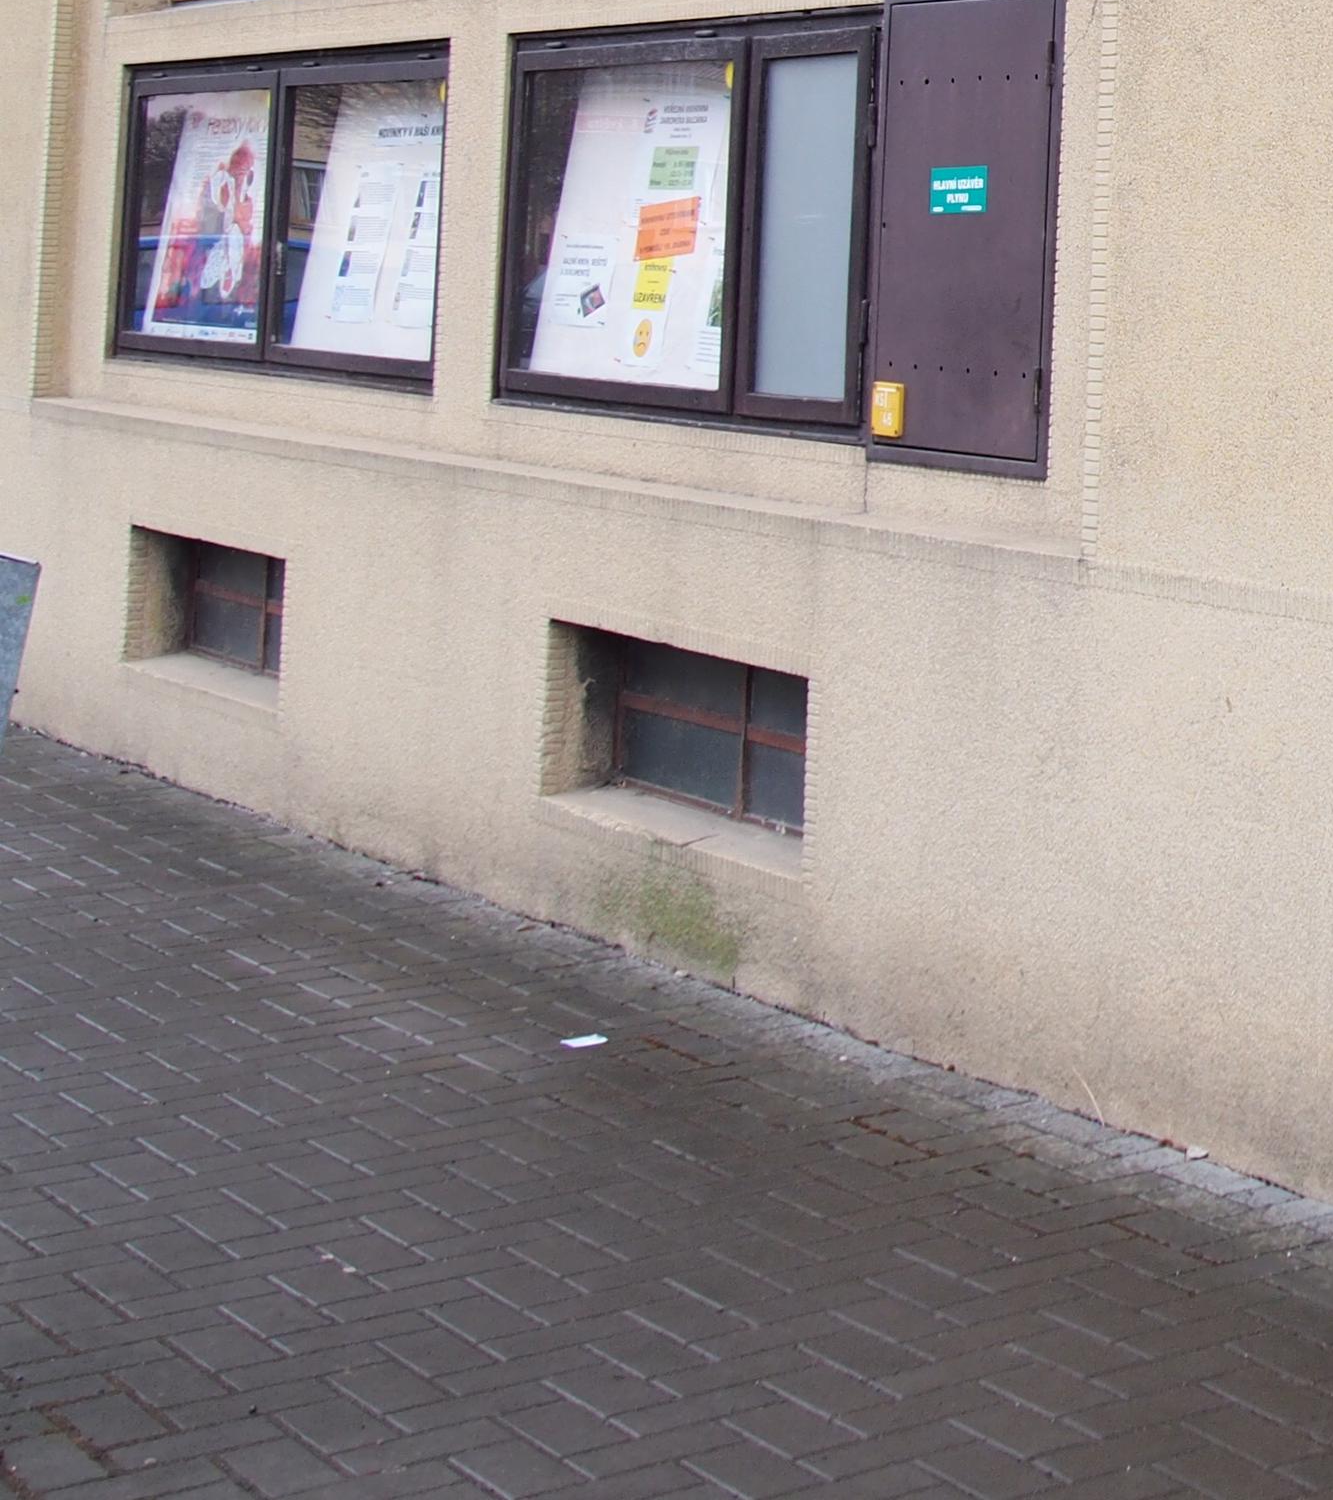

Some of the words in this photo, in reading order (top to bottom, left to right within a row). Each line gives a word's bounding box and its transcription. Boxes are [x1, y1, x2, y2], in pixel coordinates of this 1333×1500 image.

[933, 176, 957, 190] HLAVNÍ
[958, 175, 984, 189] UZÁVĚR
[946, 193, 969, 204] PLYNU
